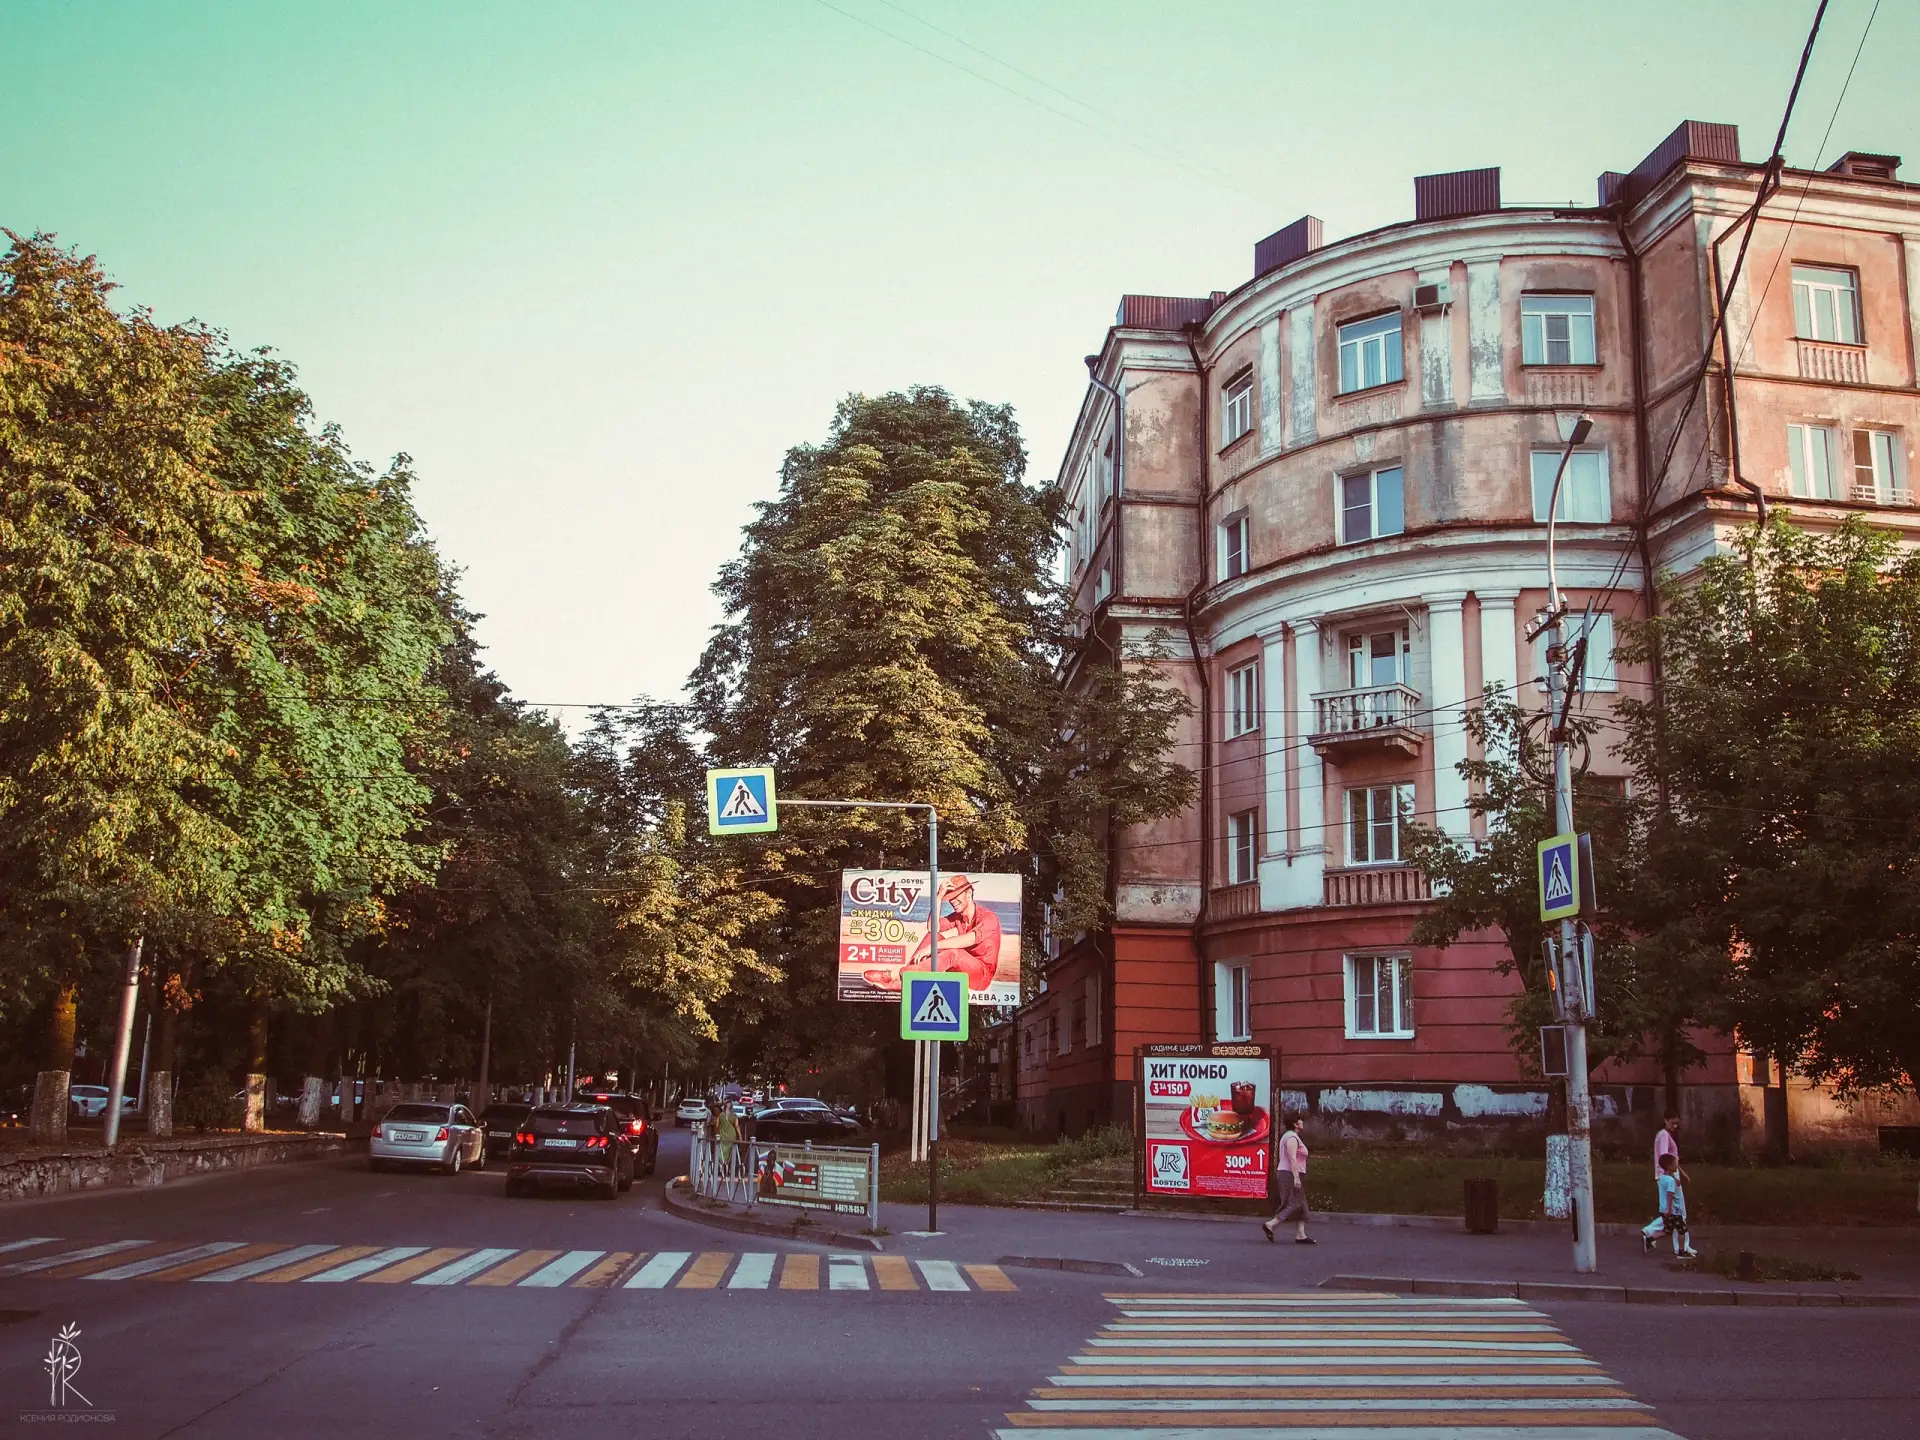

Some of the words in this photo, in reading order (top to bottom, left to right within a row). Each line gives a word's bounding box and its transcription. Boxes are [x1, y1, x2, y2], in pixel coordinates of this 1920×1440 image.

[850, 876, 921, 913] City
[850, 909, 894, 918] СКИДКИ
[847, 945, 876, 962] 2+1
[878, 946, 903, 955] Акция!
[1004, 994, 1016, 1002] 39
[1150, 1064, 1176, 1079] ХИТ
[1180, 1064, 1228, 1079] КОМБО
[1153, 1179, 1188, 1187] ROSTIC'S
